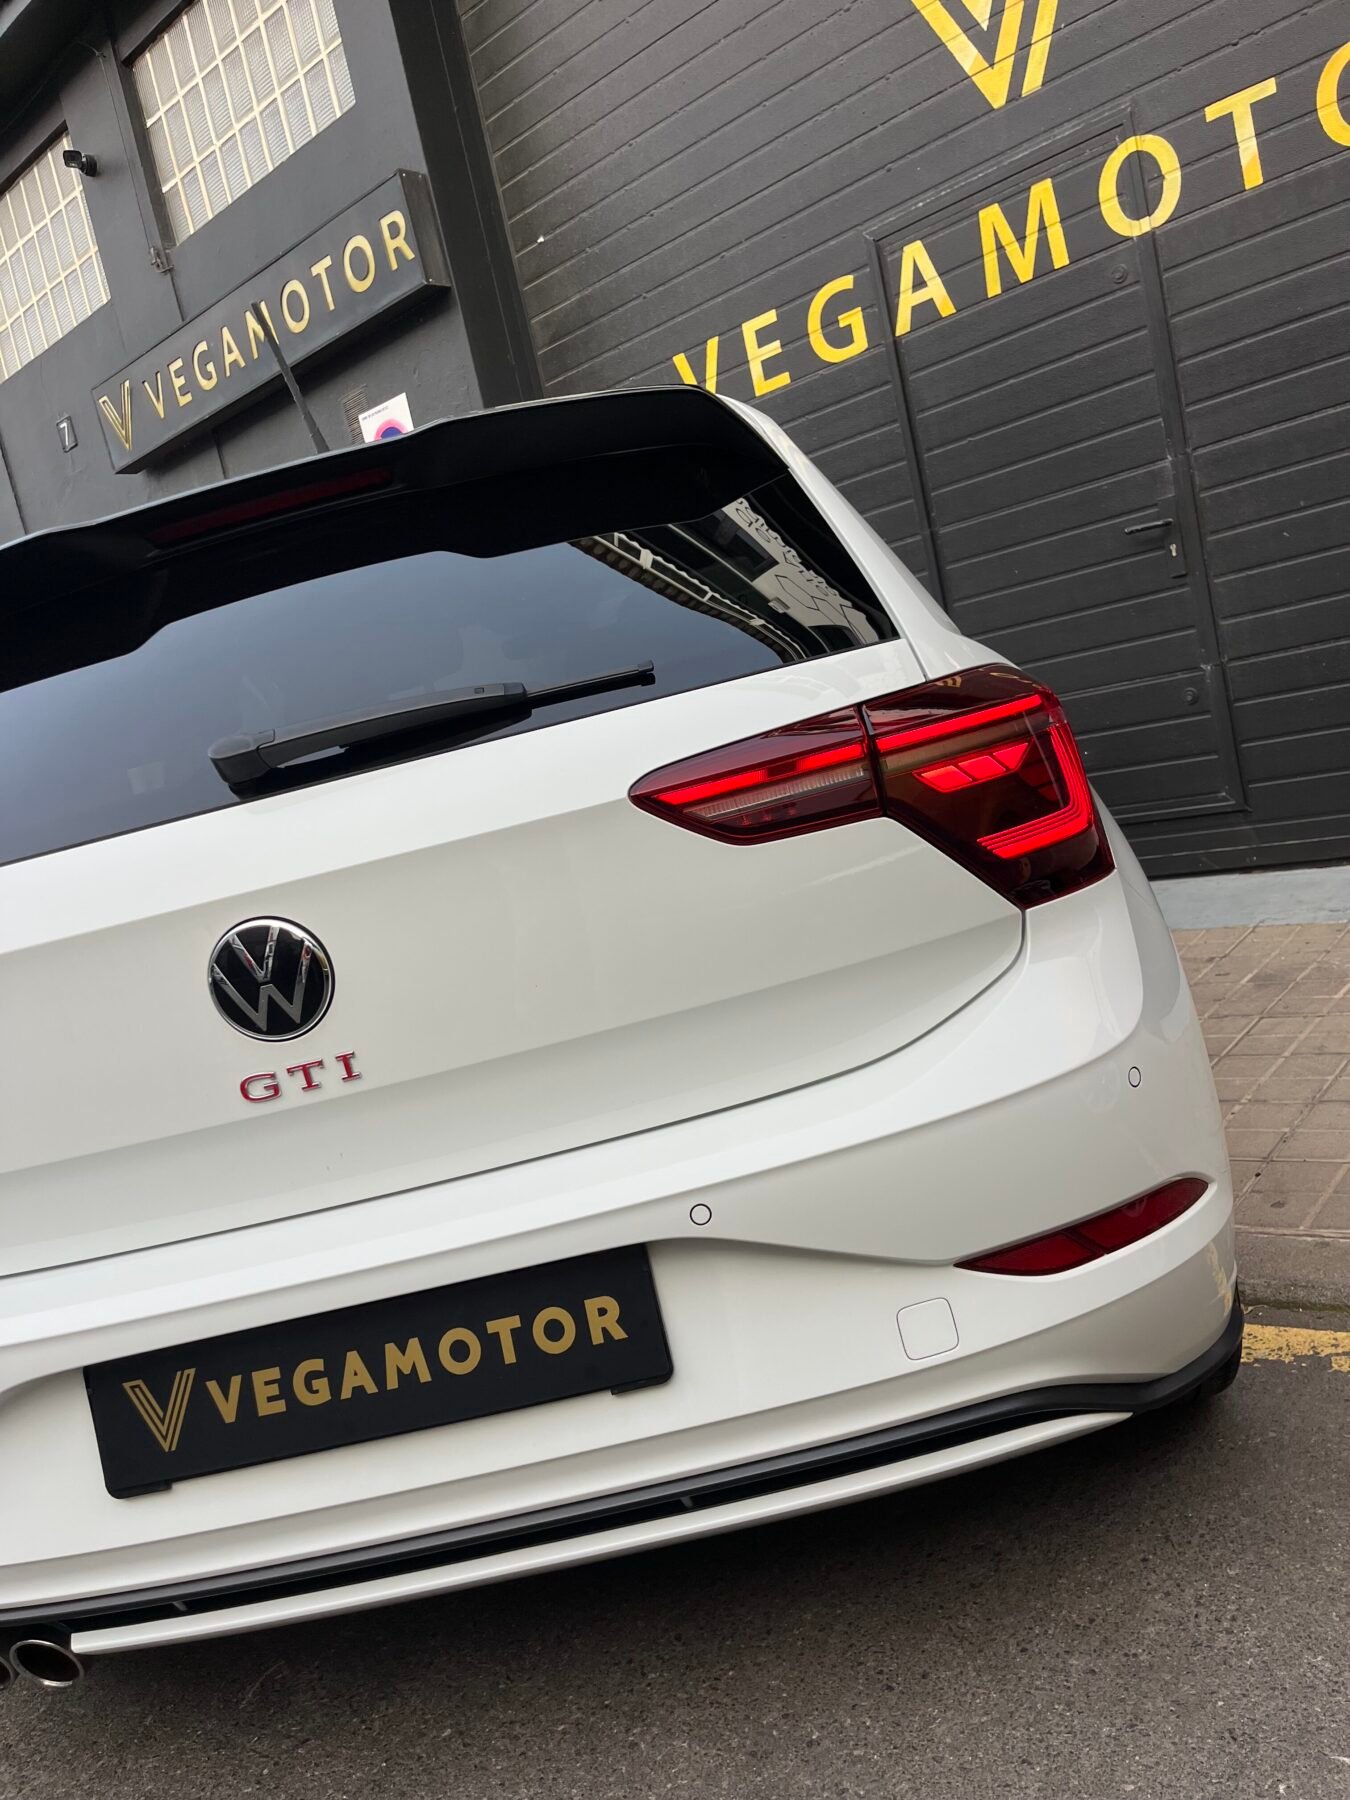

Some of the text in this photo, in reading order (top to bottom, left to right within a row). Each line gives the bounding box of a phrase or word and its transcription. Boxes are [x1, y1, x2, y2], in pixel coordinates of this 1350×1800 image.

[143, 209, 416, 420] VEGAMOTOR
[240, 1051, 361, 1103] GTI
[207, 1296, 628, 1424] VEGAMOTOR
